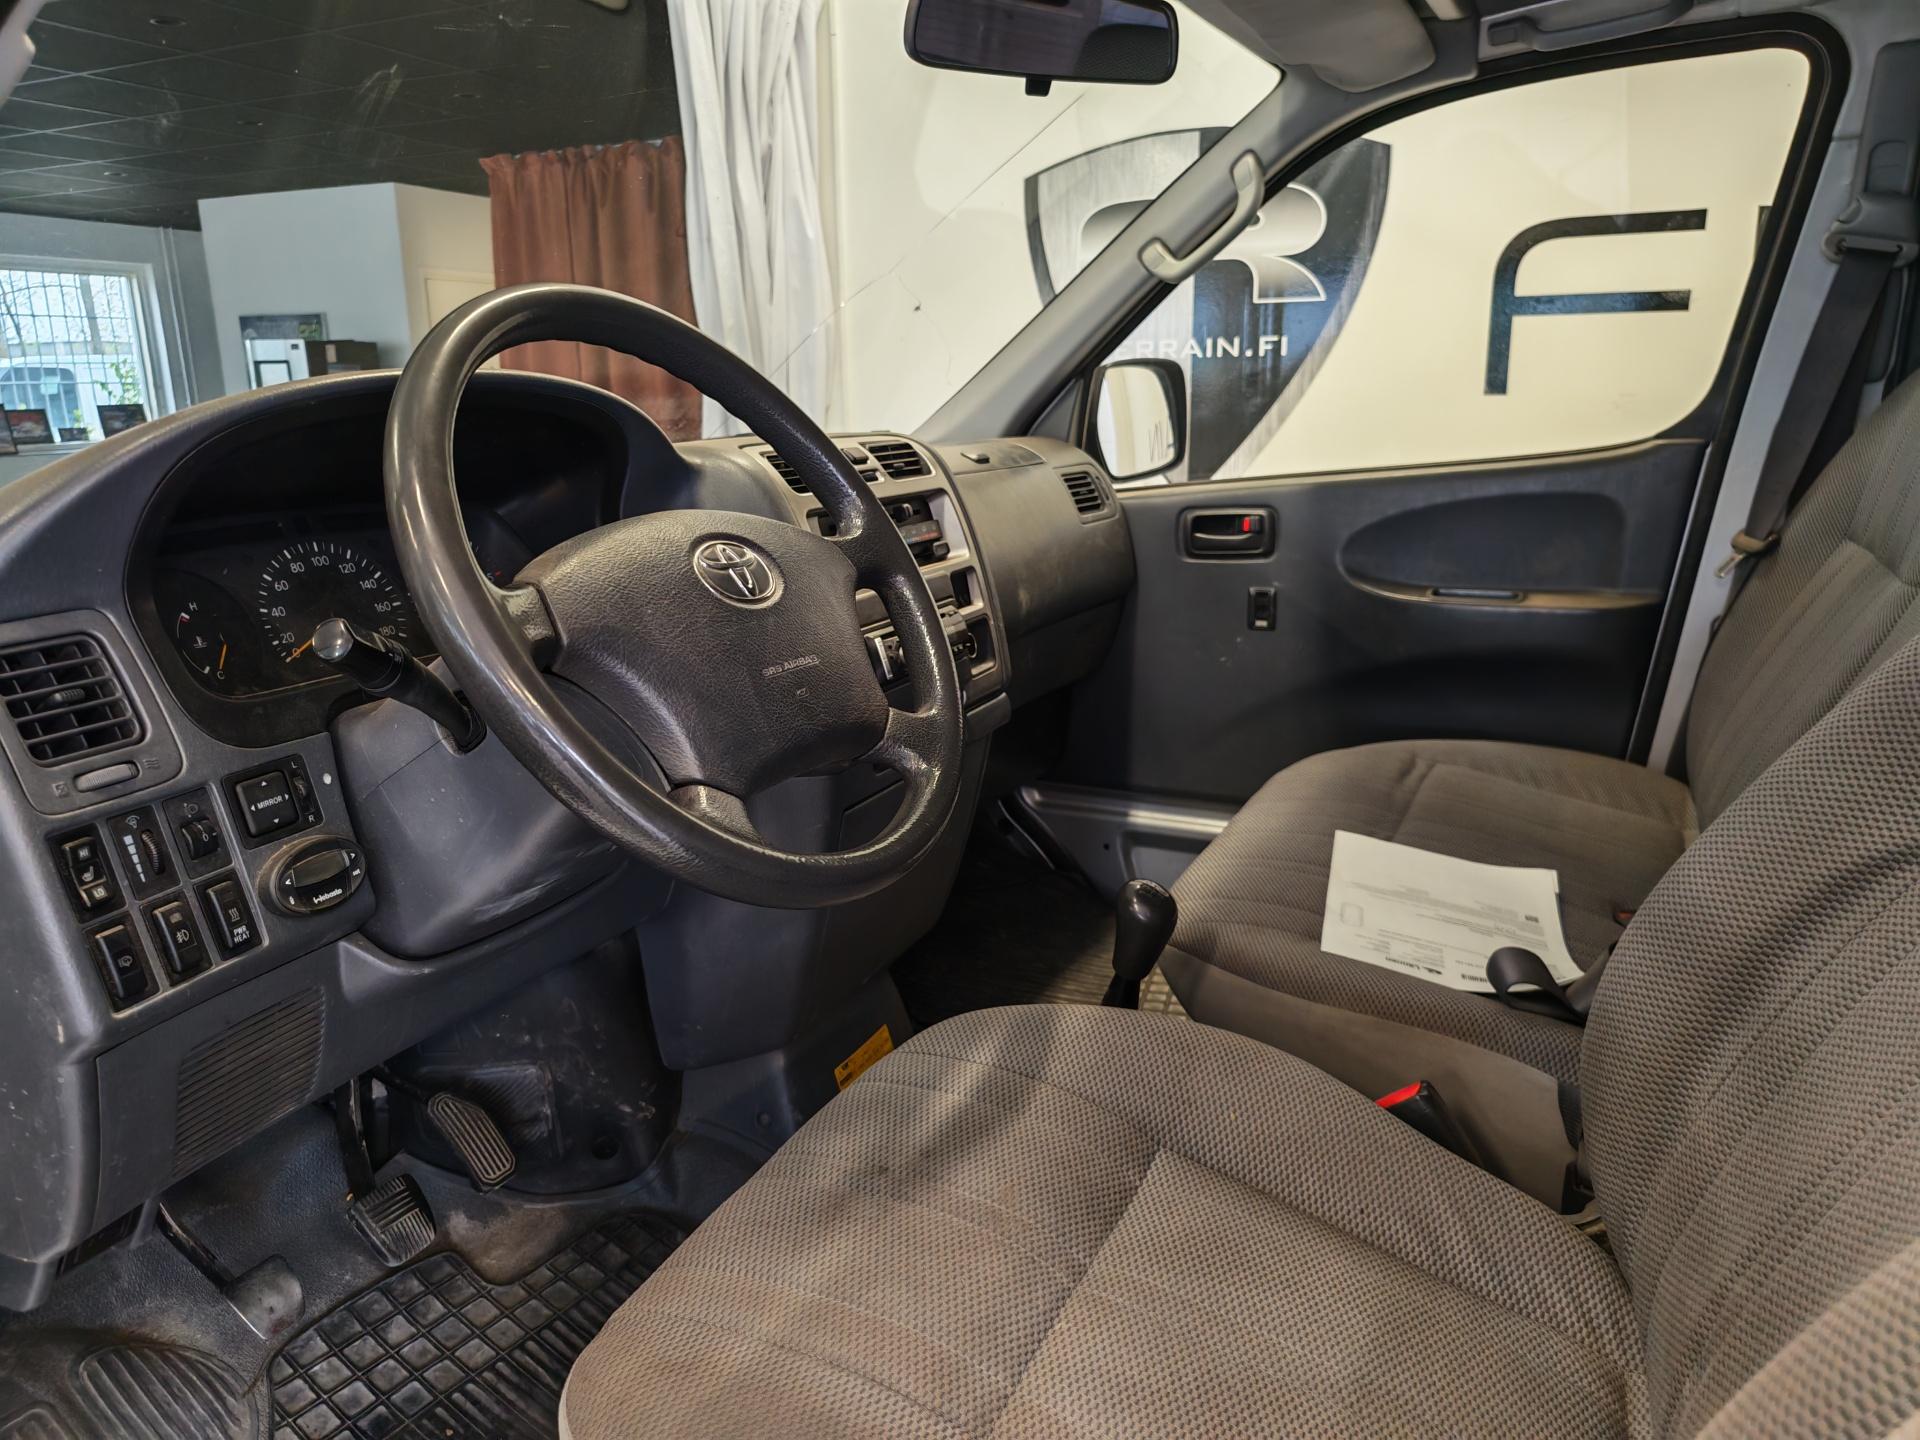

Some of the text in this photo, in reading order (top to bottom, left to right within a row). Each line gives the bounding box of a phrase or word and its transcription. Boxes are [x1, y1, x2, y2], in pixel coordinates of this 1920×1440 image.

[290, 561, 305, 573] 80
[311, 555, 330, 567] 100
[338, 562, 356, 574] 120
[274, 580, 289, 592] 60
[360, 578, 377, 590] 140
[188, 601, 198, 612] H
[271, 606, 286, 618] 40
[374, 601, 391, 612] 160
[378, 625, 396, 637] 180
[280, 632, 295, 644] 20
[762, 654, 818, 677] SRS AIRBAG
[216, 669, 226, 680] C
[257, 795, 284, 810] MIRROR
[308, 814, 316, 823] R
[79, 847, 89, 858] HI
[92, 887, 105, 899] LO
[233, 925, 247, 937] PWR
[233, 930, 250, 944] HEAT
